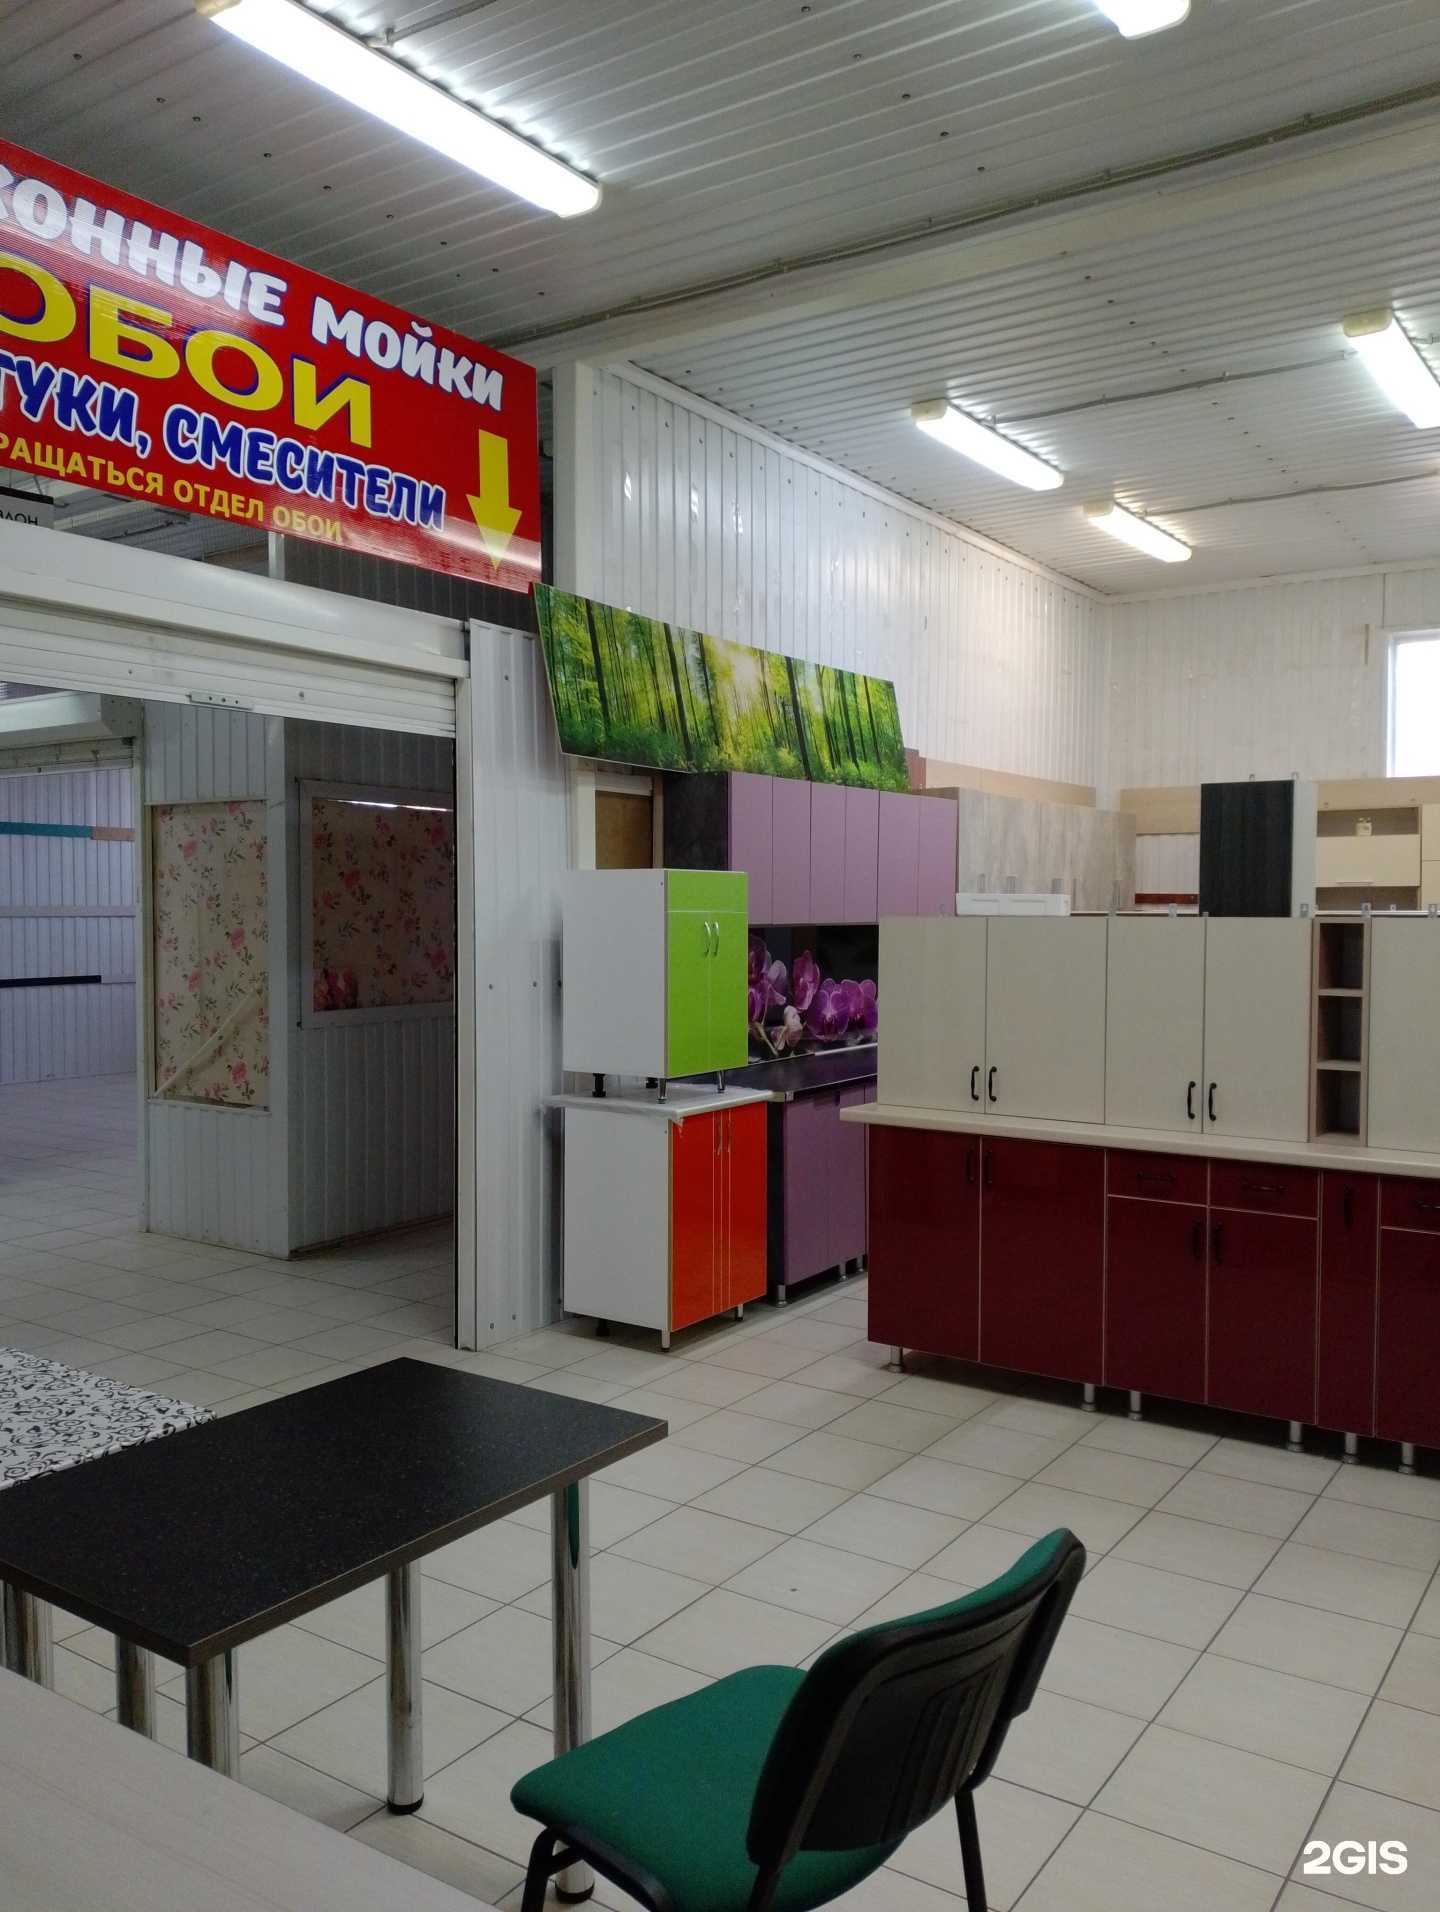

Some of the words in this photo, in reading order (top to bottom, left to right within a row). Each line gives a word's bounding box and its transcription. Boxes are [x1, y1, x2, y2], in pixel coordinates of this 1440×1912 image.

[0, 250, 371, 448] ОБОИ
[312, 296, 503, 411] МОЙКИ
[163, 404, 446, 531] СМЕСИТЕЛИ
[173, 479, 264, 522] ОТДЕЛ
[272, 506, 343, 544] ОБОИ
